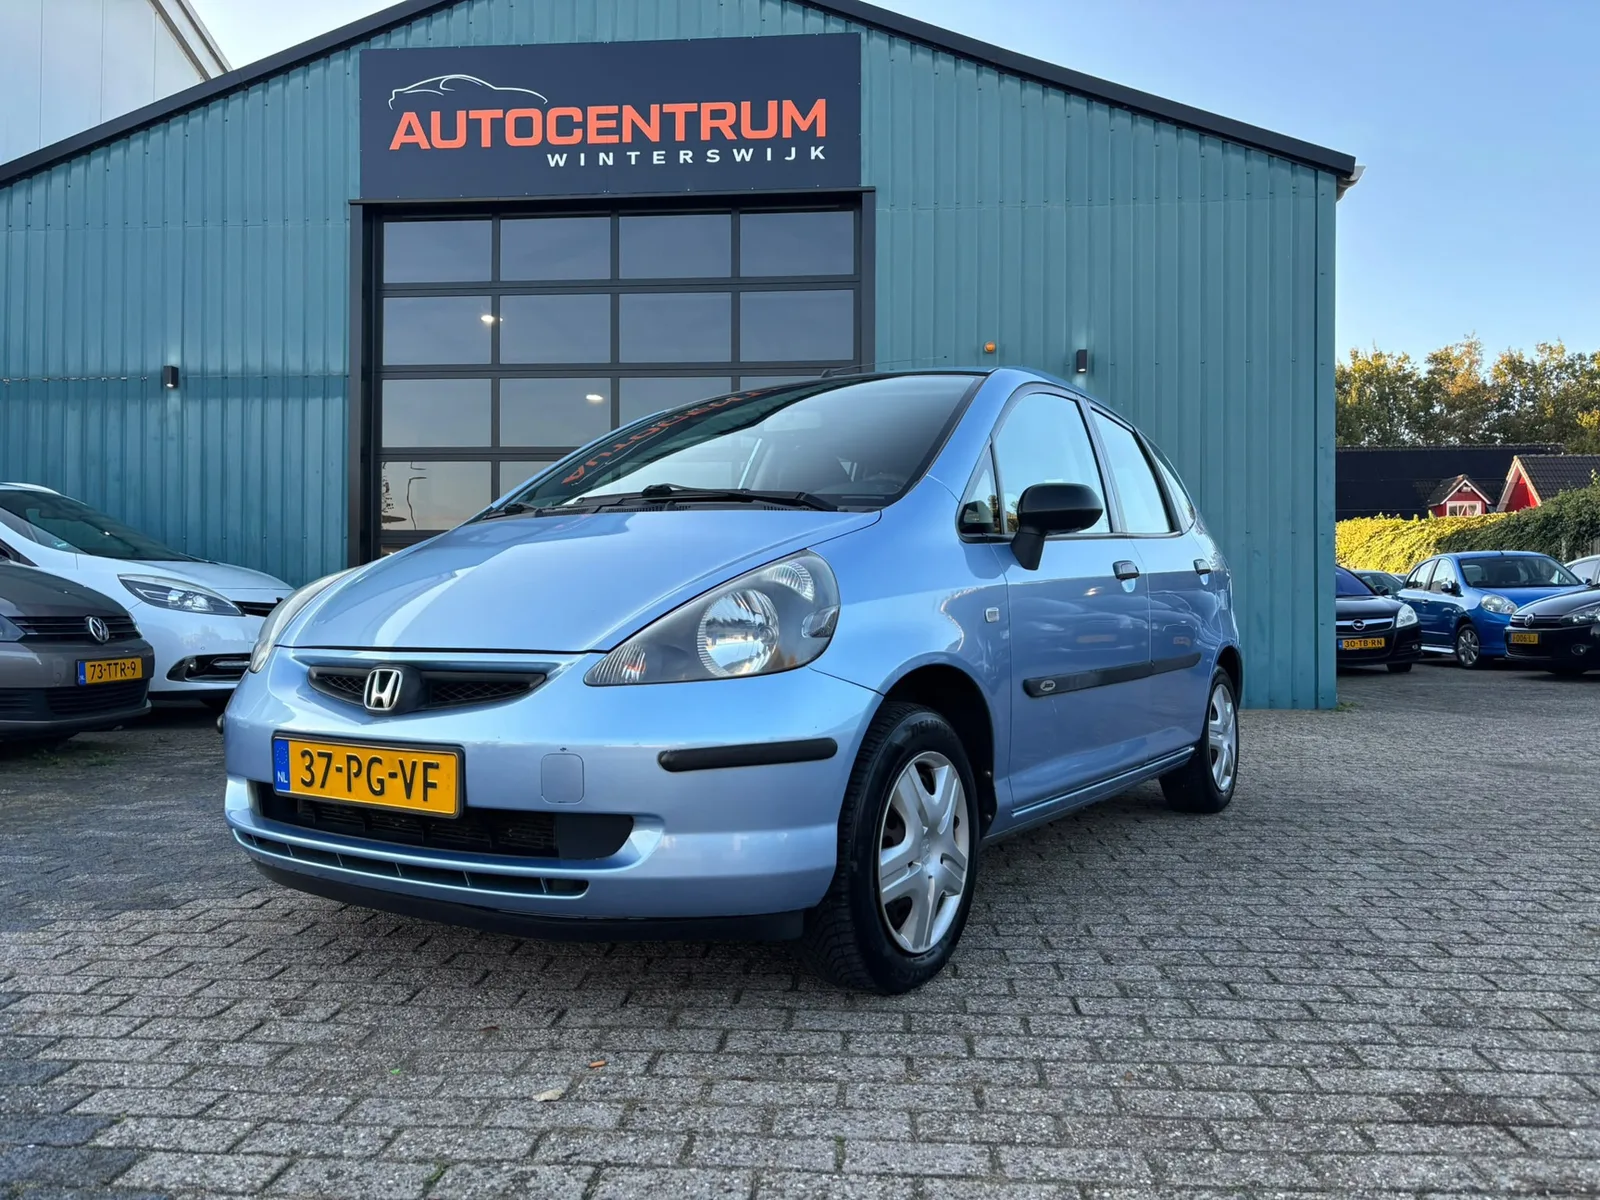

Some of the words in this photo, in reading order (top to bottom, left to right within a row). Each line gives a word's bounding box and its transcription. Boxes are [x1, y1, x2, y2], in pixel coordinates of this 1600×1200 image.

[390, 99, 827, 150] AUTOCENTRUM
[547, 145, 826, 168] WINTERSWIJK
[277, 771, 288, 783] NL
[300, 749, 439, 801] 37-PG-VF
